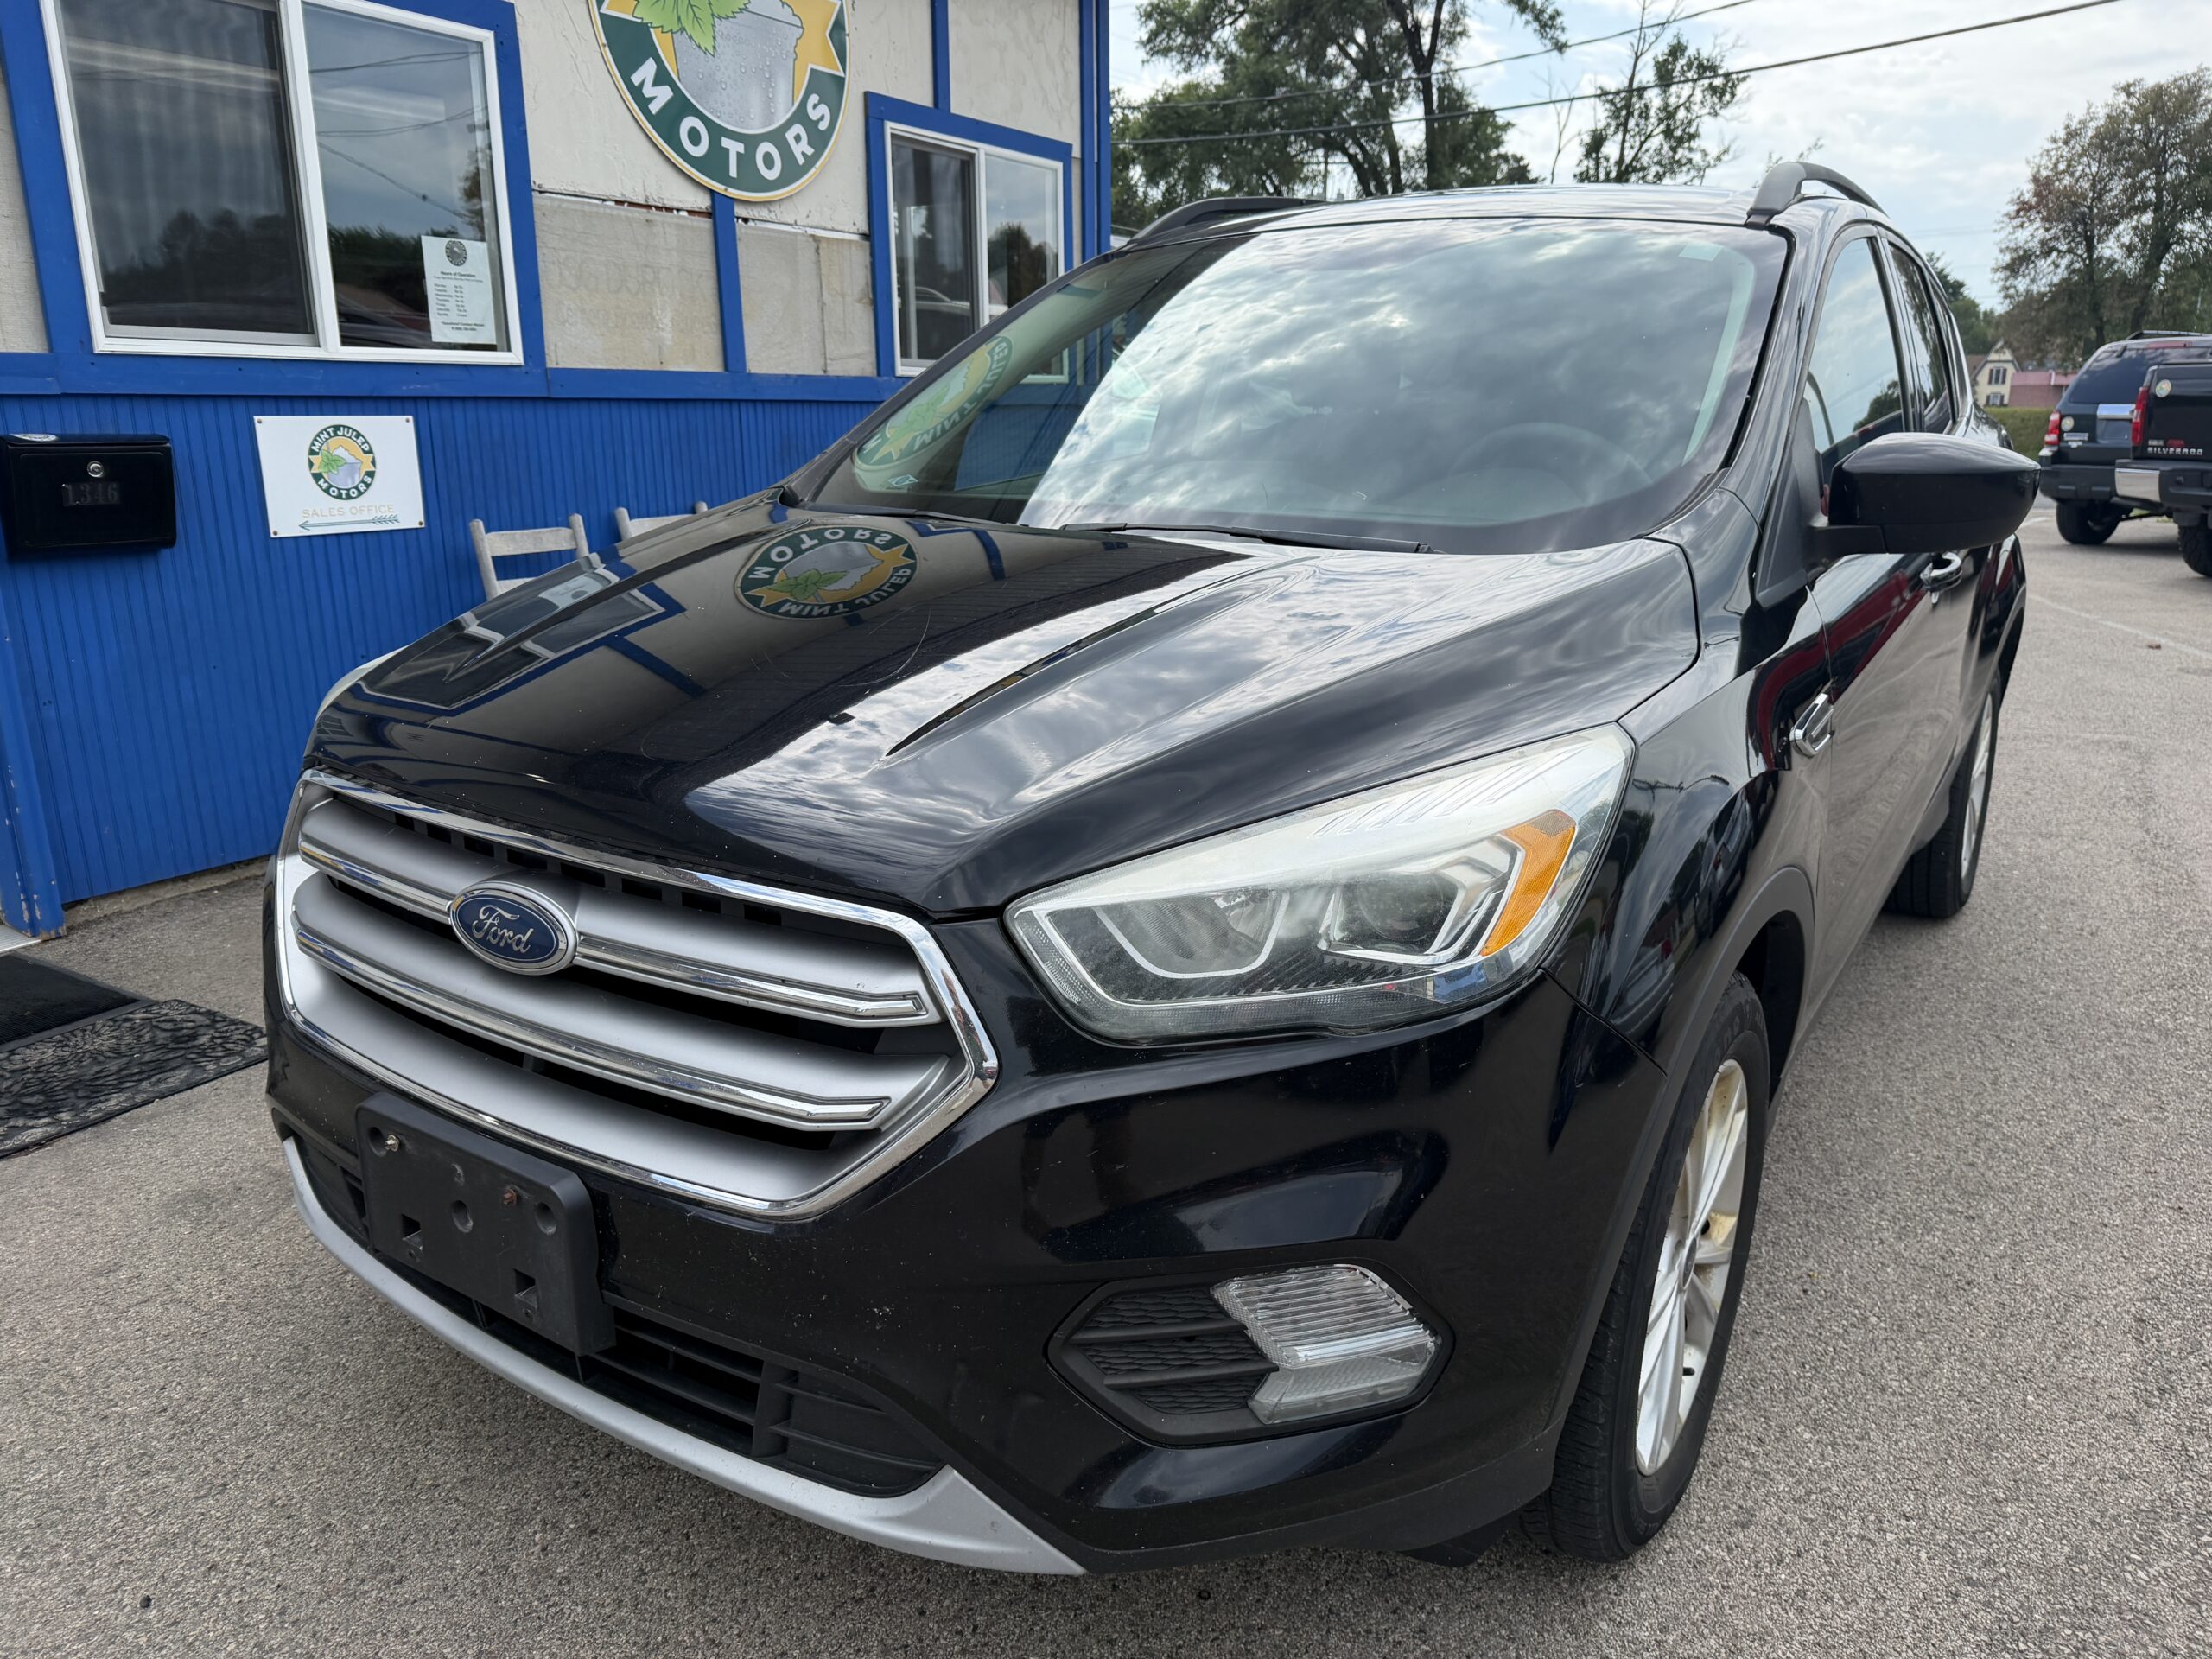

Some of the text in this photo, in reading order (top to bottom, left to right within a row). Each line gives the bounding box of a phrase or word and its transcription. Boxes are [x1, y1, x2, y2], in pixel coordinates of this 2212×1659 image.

[630, 57, 831, 181] MOTORS
[311, 427, 370, 452] MINT JULEP
[2147, 447, 2203, 456] SILVERADO
[63, 483, 119, 505] 1346
[318, 475, 372, 499] MOTORS
[302, 504, 395, 518] SALES OFFICE
[472, 904, 534, 954] Ford
